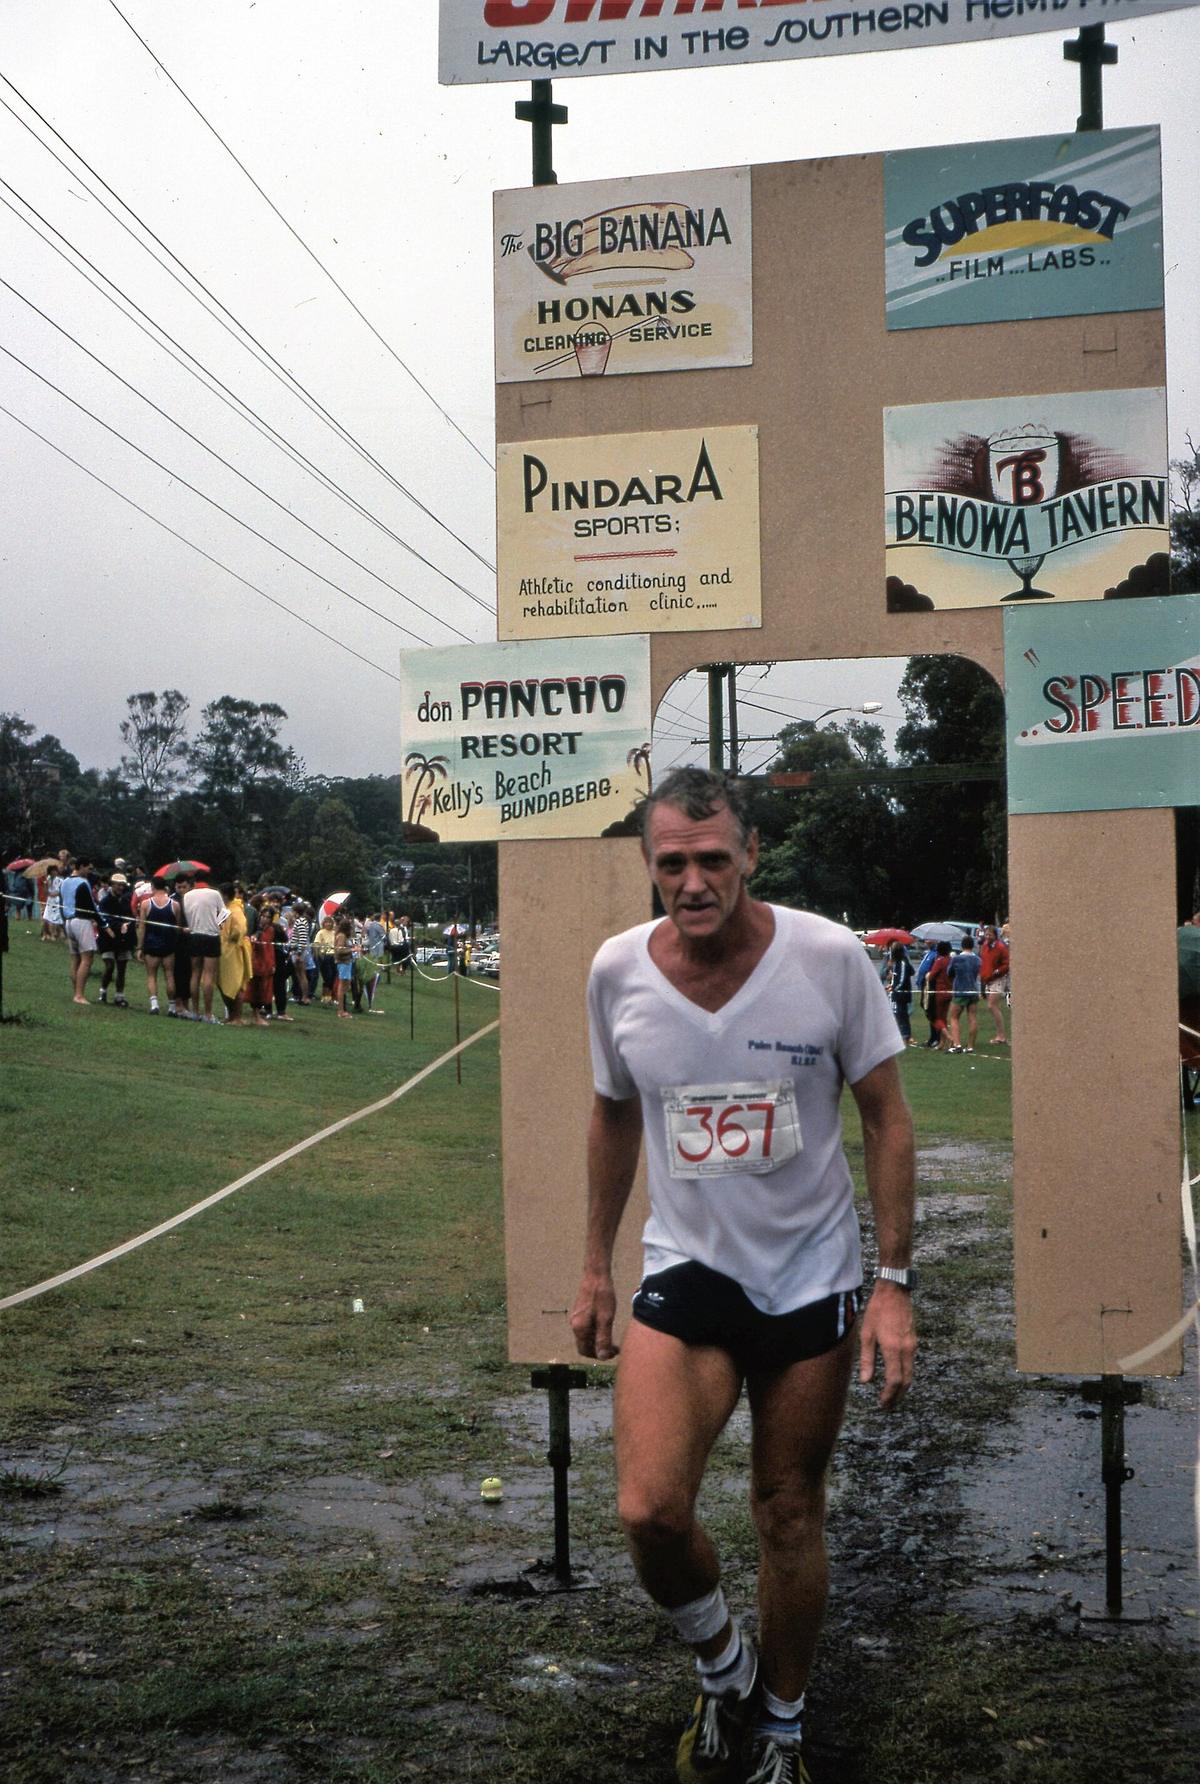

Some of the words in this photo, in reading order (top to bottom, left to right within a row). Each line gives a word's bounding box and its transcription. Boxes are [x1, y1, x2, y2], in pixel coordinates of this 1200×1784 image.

[634, 36, 668, 60] IN
[501, 232, 525, 257] The
[535, 219, 584, 261] BIG
[600, 207, 732, 254] BANANA
[902, 181, 1132, 267] SUPERFAST
[537, 289, 697, 324] HONANS
[524, 331, 608, 353] CLEANING
[629, 322, 712, 343] SERVICE
[523, 437, 724, 513] PINDARA
[895, 494, 1031, 555] BENOWA
[1040, 479, 1166, 548] TAVERN
[519, 577, 574, 597] Athletic
[587, 573, 686, 593] conditioning
[700, 567, 732, 585] and
[523, 598, 628, 618] rehabilitation
[417, 690, 453, 723] don
[460, 674, 627, 721] PANCHO
[461, 731, 583, 759] RESORT
[433, 780, 484, 819] Kelly's
[495, 760, 551, 801] Beach
[677, 1103, 774, 1162] 367
